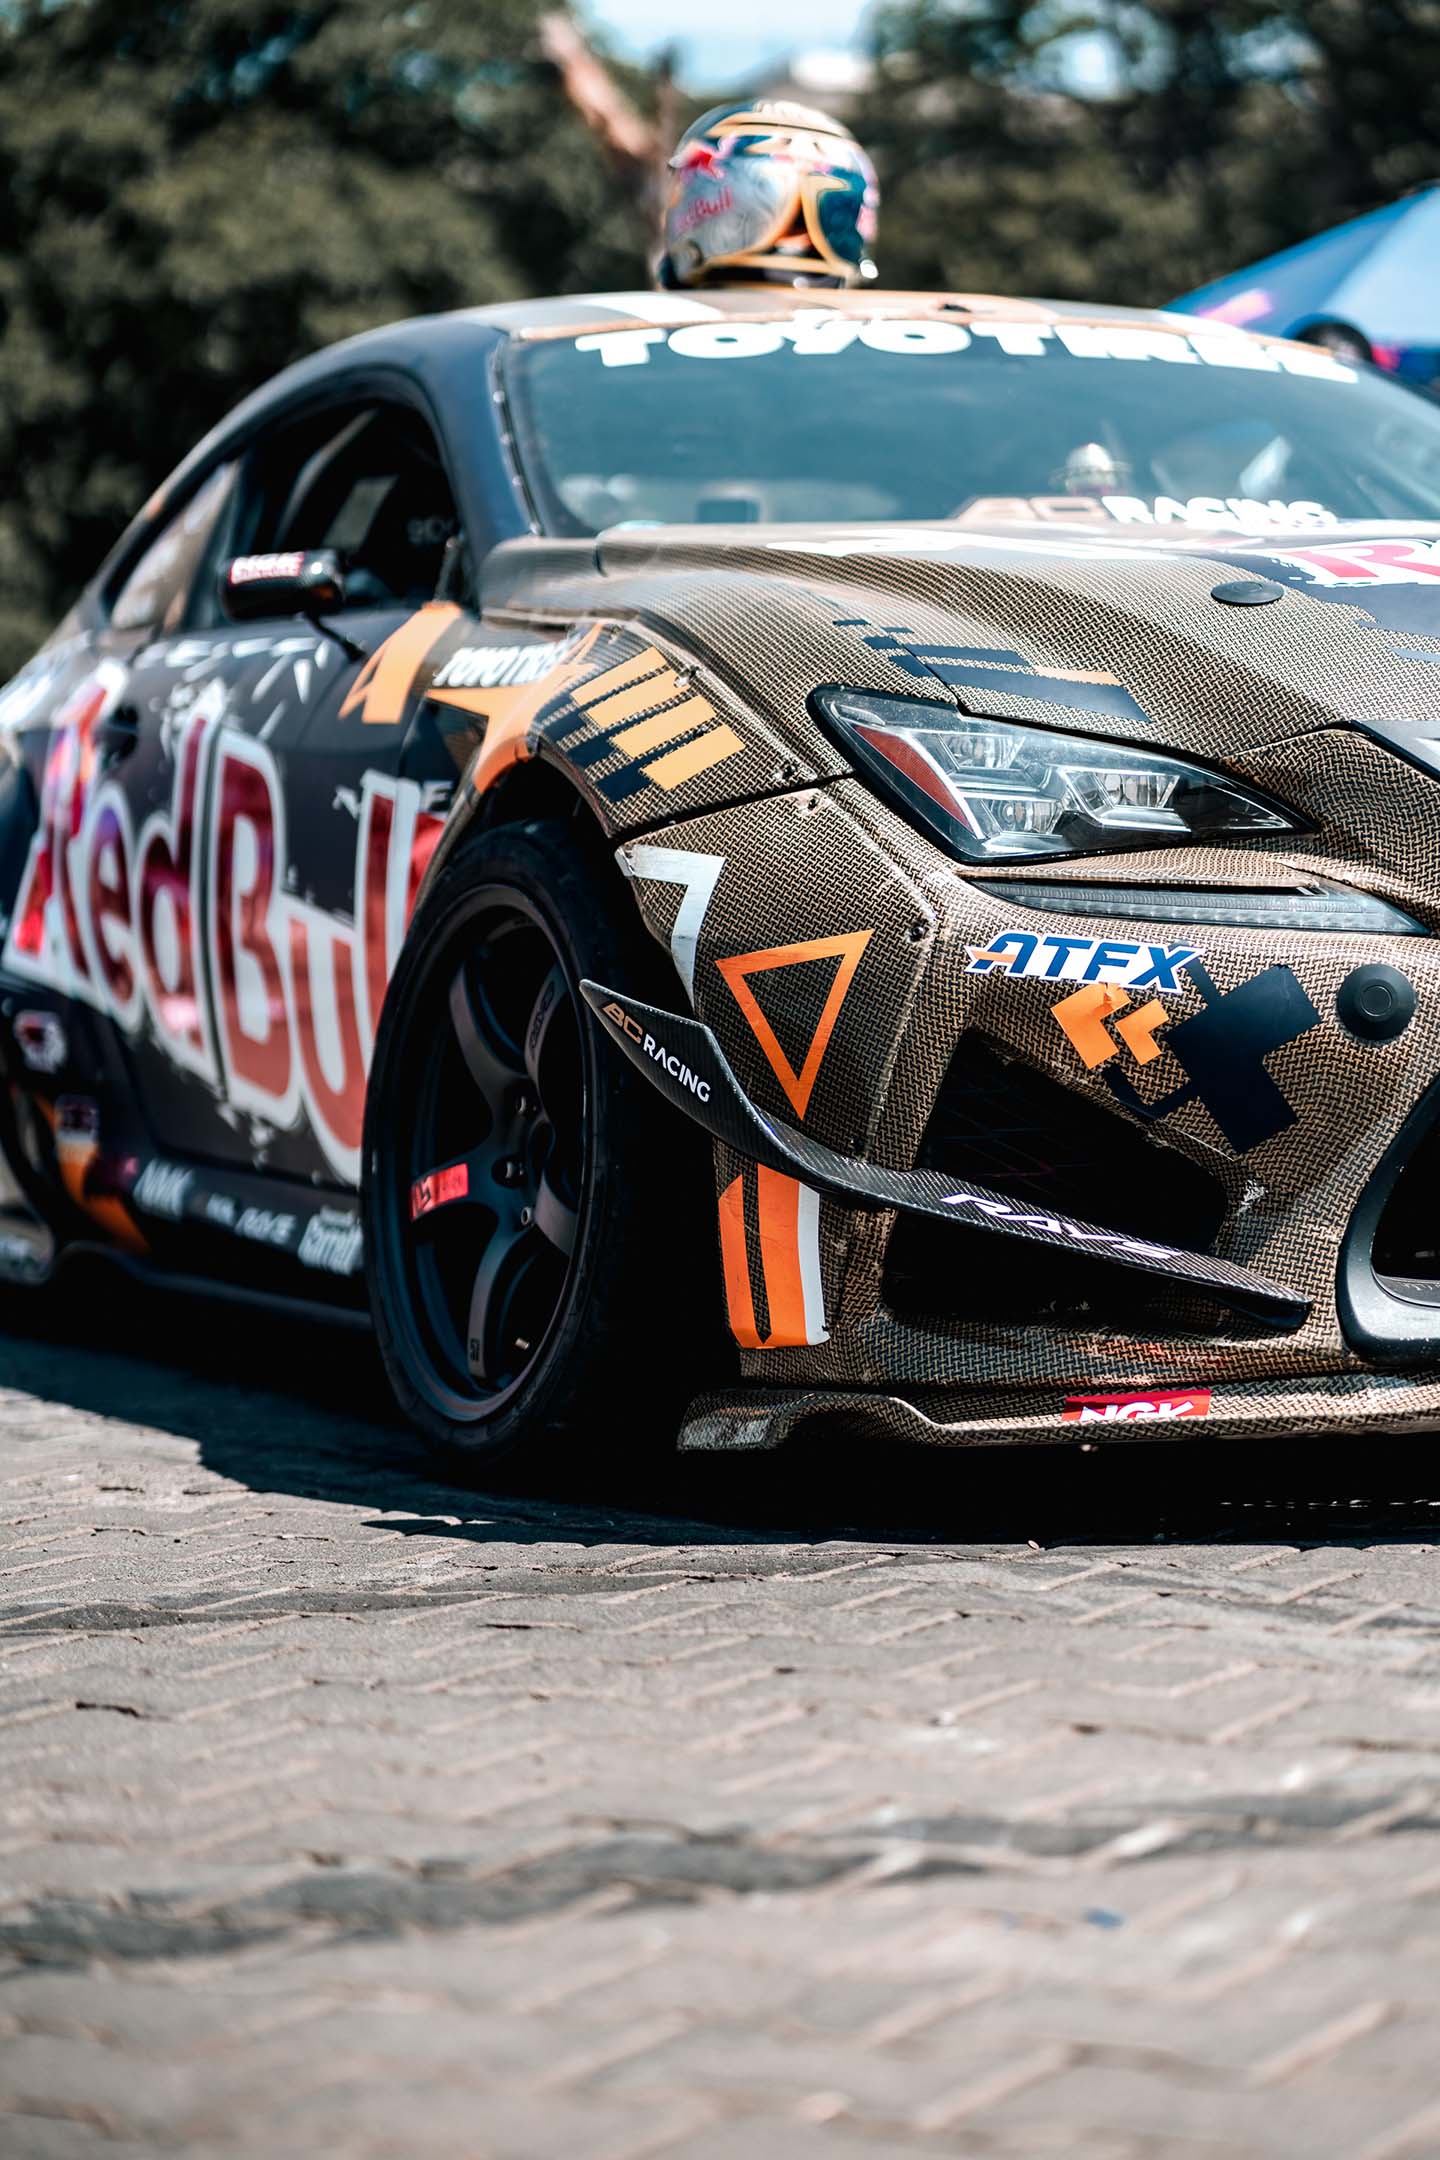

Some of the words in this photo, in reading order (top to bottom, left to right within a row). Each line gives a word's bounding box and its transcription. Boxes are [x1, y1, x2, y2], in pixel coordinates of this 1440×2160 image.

[970, 931, 1196, 990] ATFX
[602, 1002, 643, 1044] BC
[643, 1033, 711, 1103] RACING
[940, 1193, 1182, 1259] RAYS
